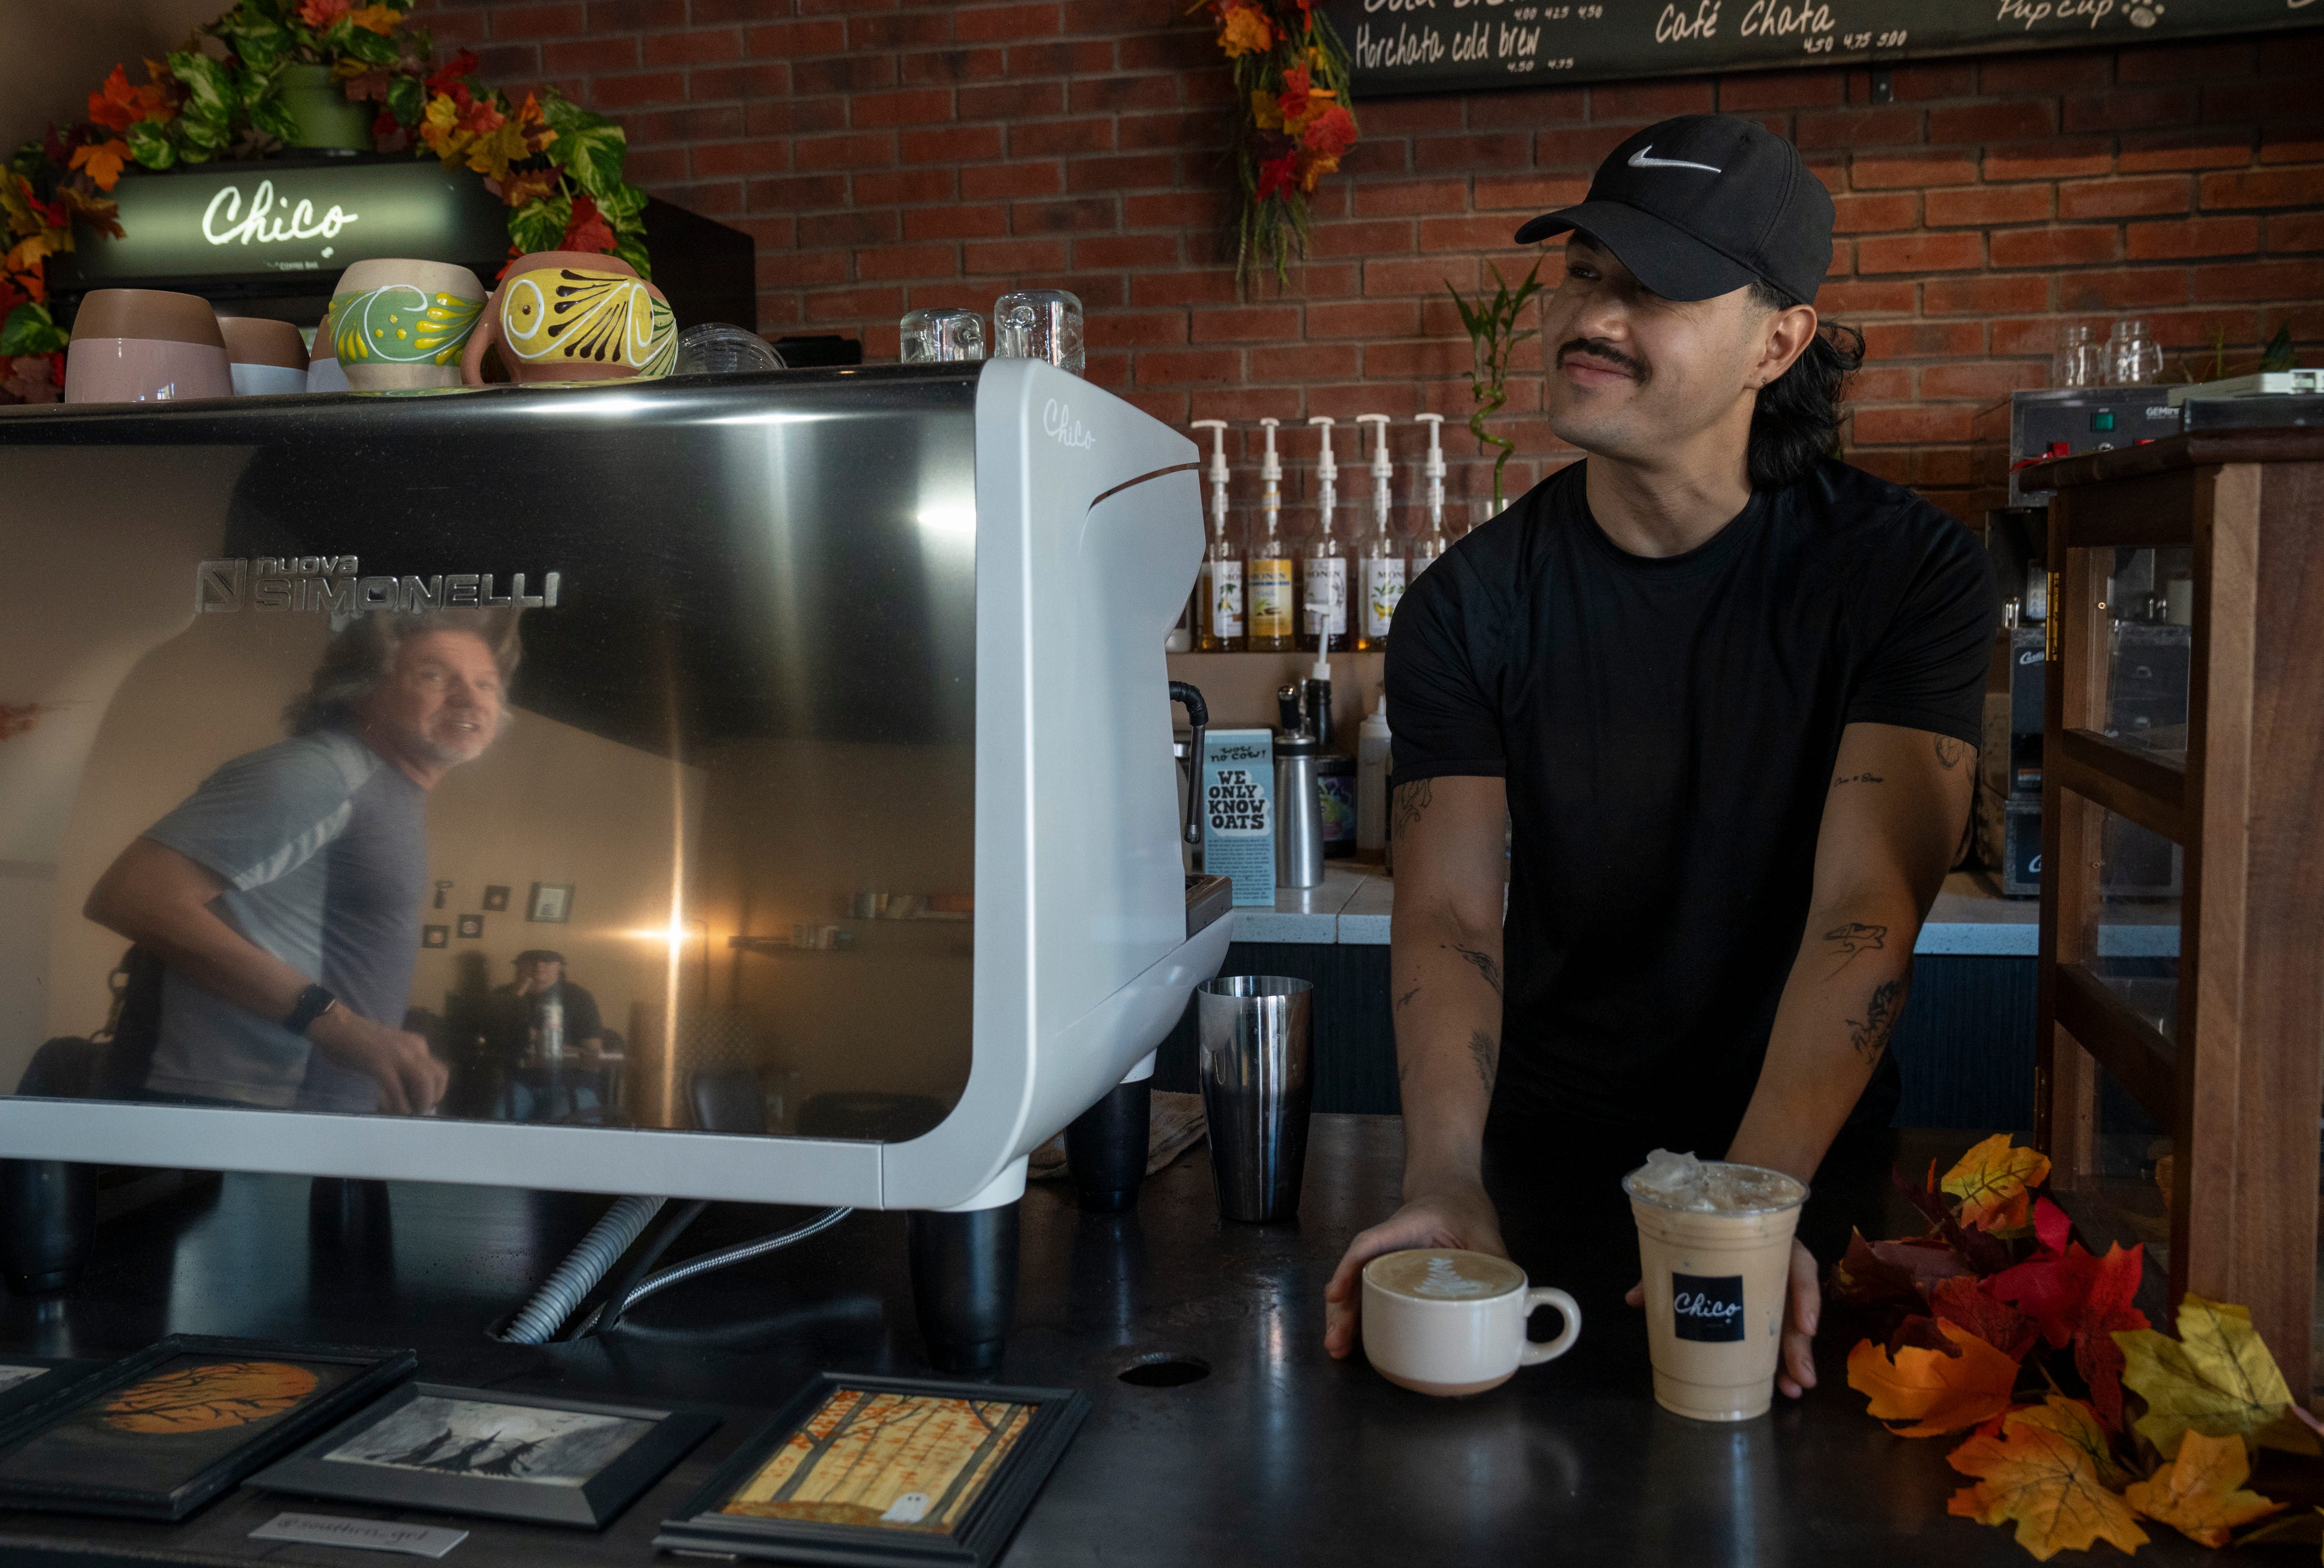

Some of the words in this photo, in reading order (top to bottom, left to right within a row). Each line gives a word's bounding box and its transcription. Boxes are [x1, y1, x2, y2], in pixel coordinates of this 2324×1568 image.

[1655, 0, 1722, 43] Café
[1741, 0, 1835, 37] Chata
[2056, 0, 2114, 29] cup
[1356, 21, 1445, 69] Horchata
[1452, 20, 1489, 61] cold
[1499, 21, 1540, 57] brew
[203, 180, 358, 245] Chico
[1044, 398, 1096, 450] Chico
[259, 555, 358, 575] nuova
[254, 571, 560, 612] SIMONELLI
[1232, 750, 1266, 760] cow!
[1217, 770, 1246, 785] WE
[1209, 785, 1258, 798] ONLY
[1208, 799, 1265, 814] KNOW
[1211, 814, 1264, 829] OATS
[1674, 1292, 1742, 1317] Chico
